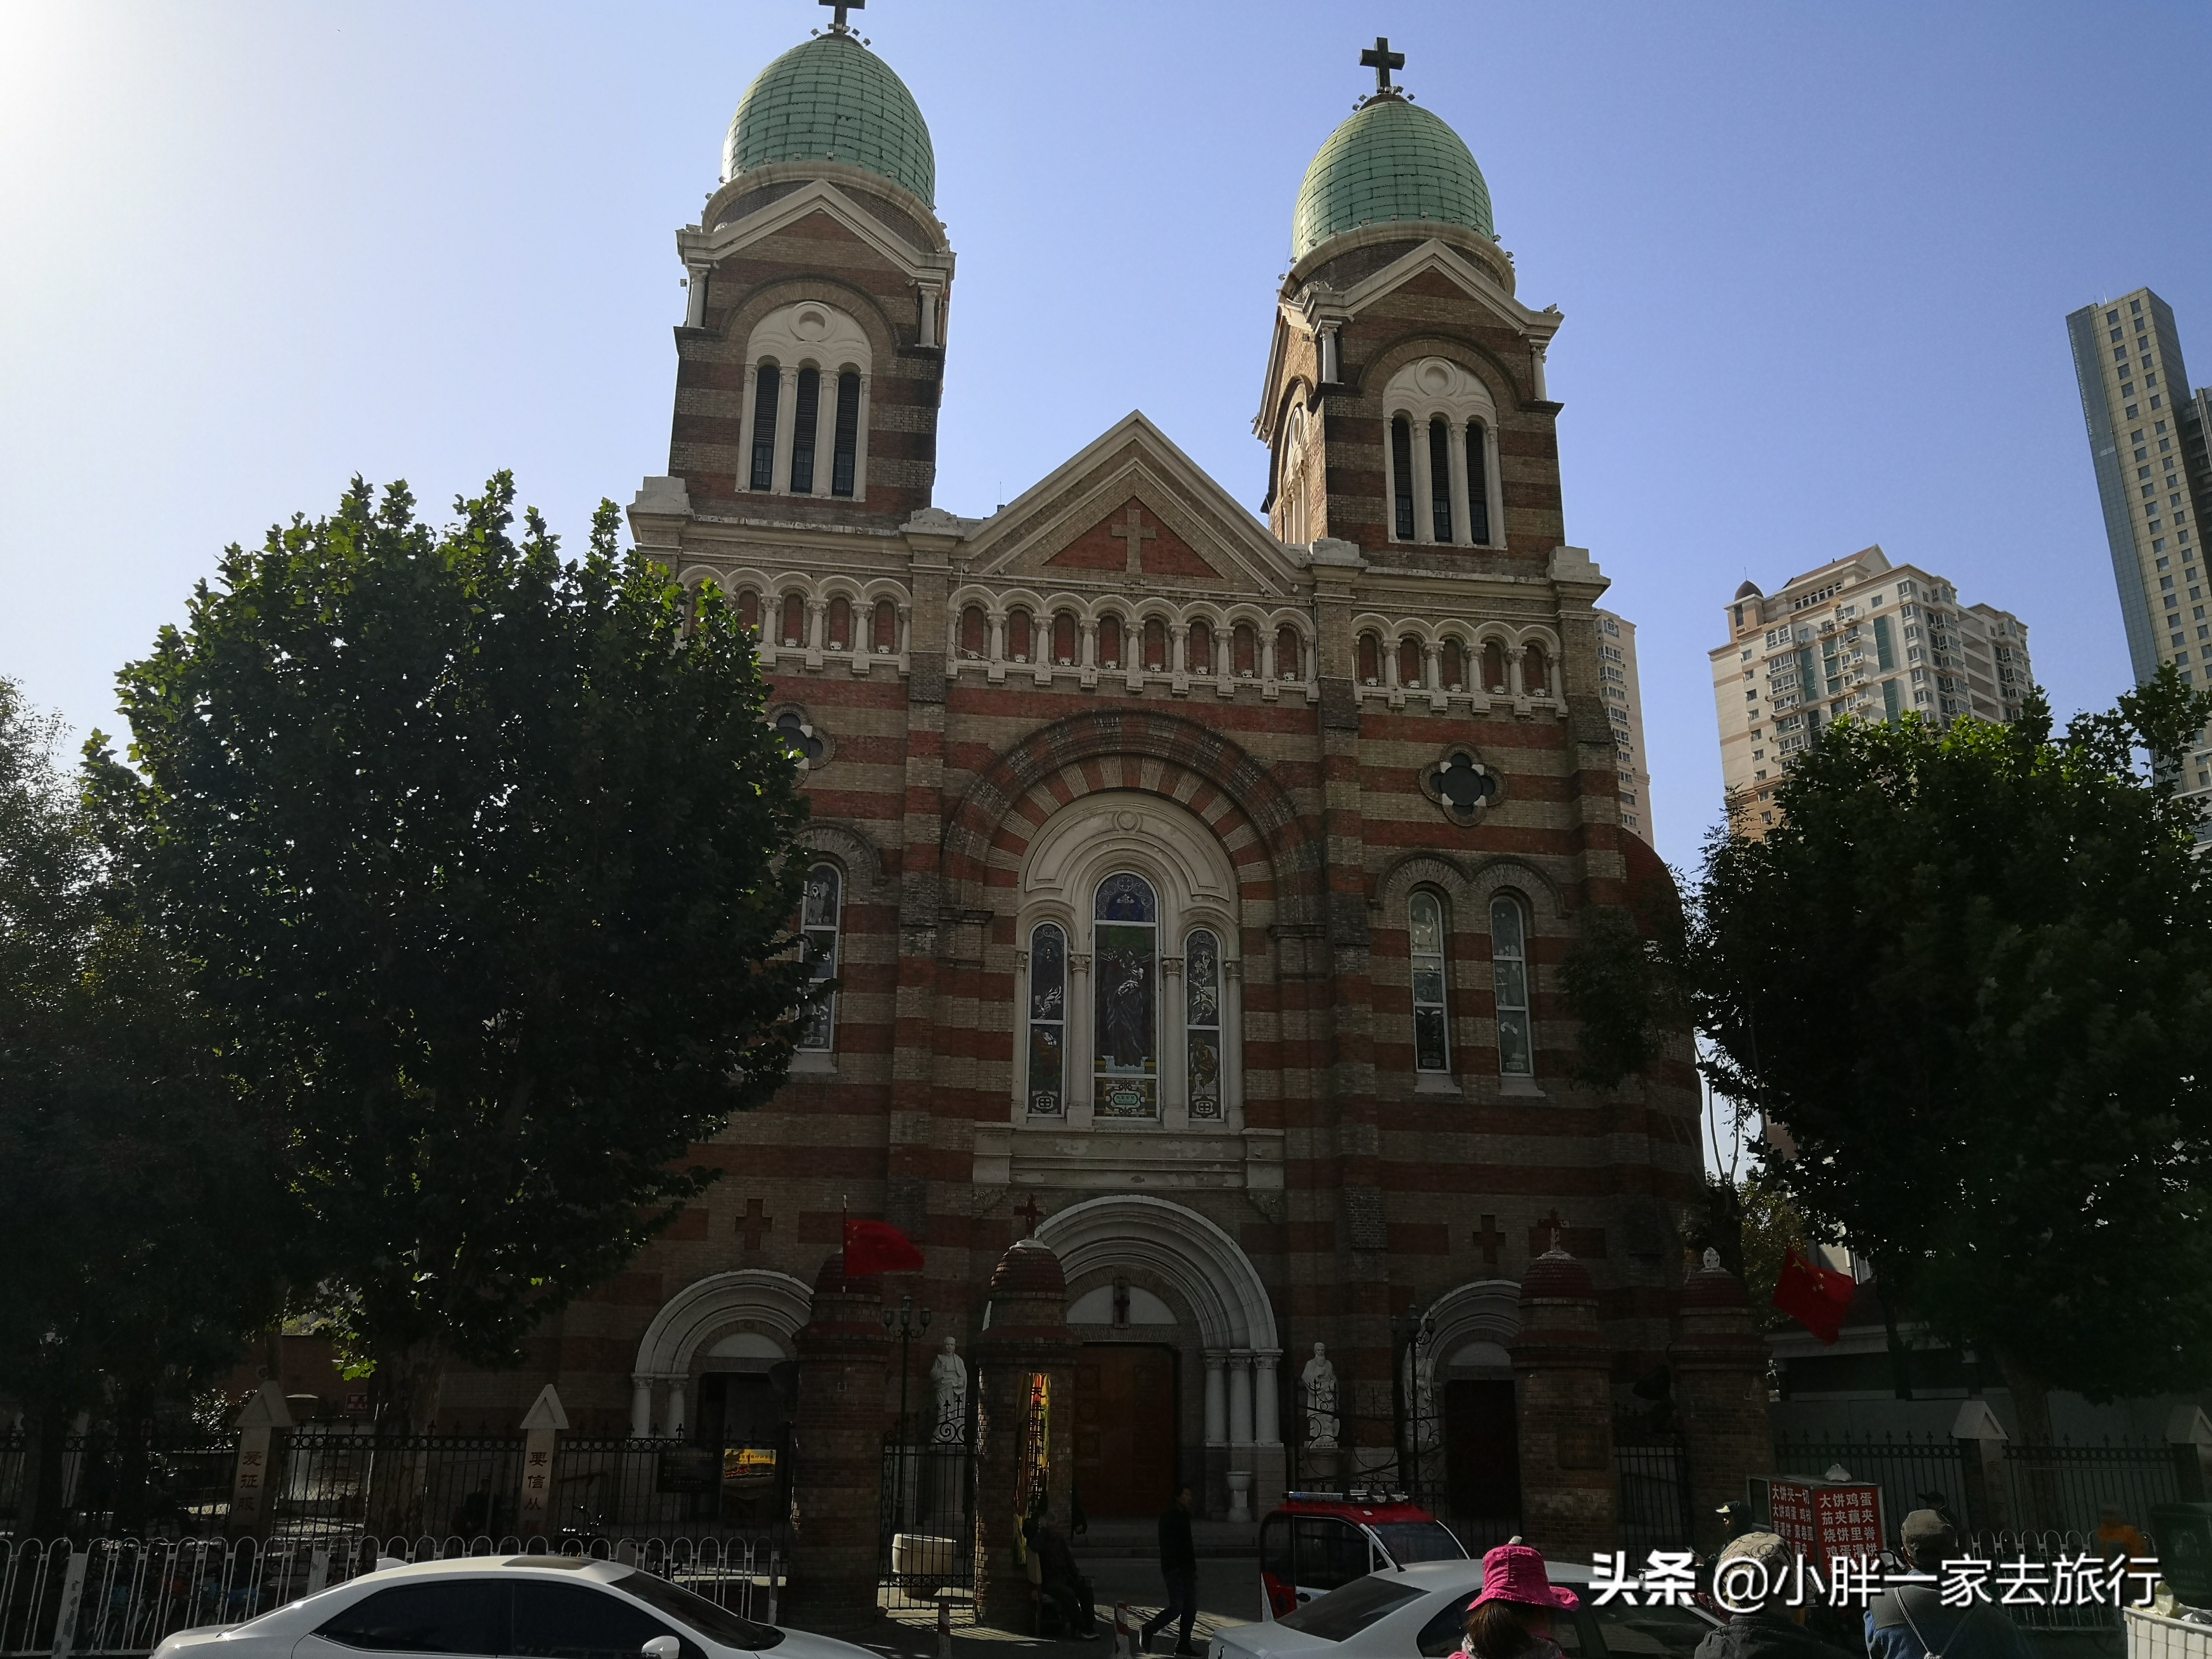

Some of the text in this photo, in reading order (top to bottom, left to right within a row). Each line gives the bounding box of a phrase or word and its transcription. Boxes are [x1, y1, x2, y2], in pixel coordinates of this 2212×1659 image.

[1772, 1484, 1810, 1505] 大饼夹一切
[1819, 1492, 1873, 1509] 大饼鸡蛋
[1773, 1503, 1797, 1521] 大饼鸡蛋
[1821, 1508, 1875, 1526] 茄夹藕夹
[1823, 1526, 1876, 1543] 烧饼里脊
[1825, 1542, 1878, 1559] 鸡蛋灌饼
